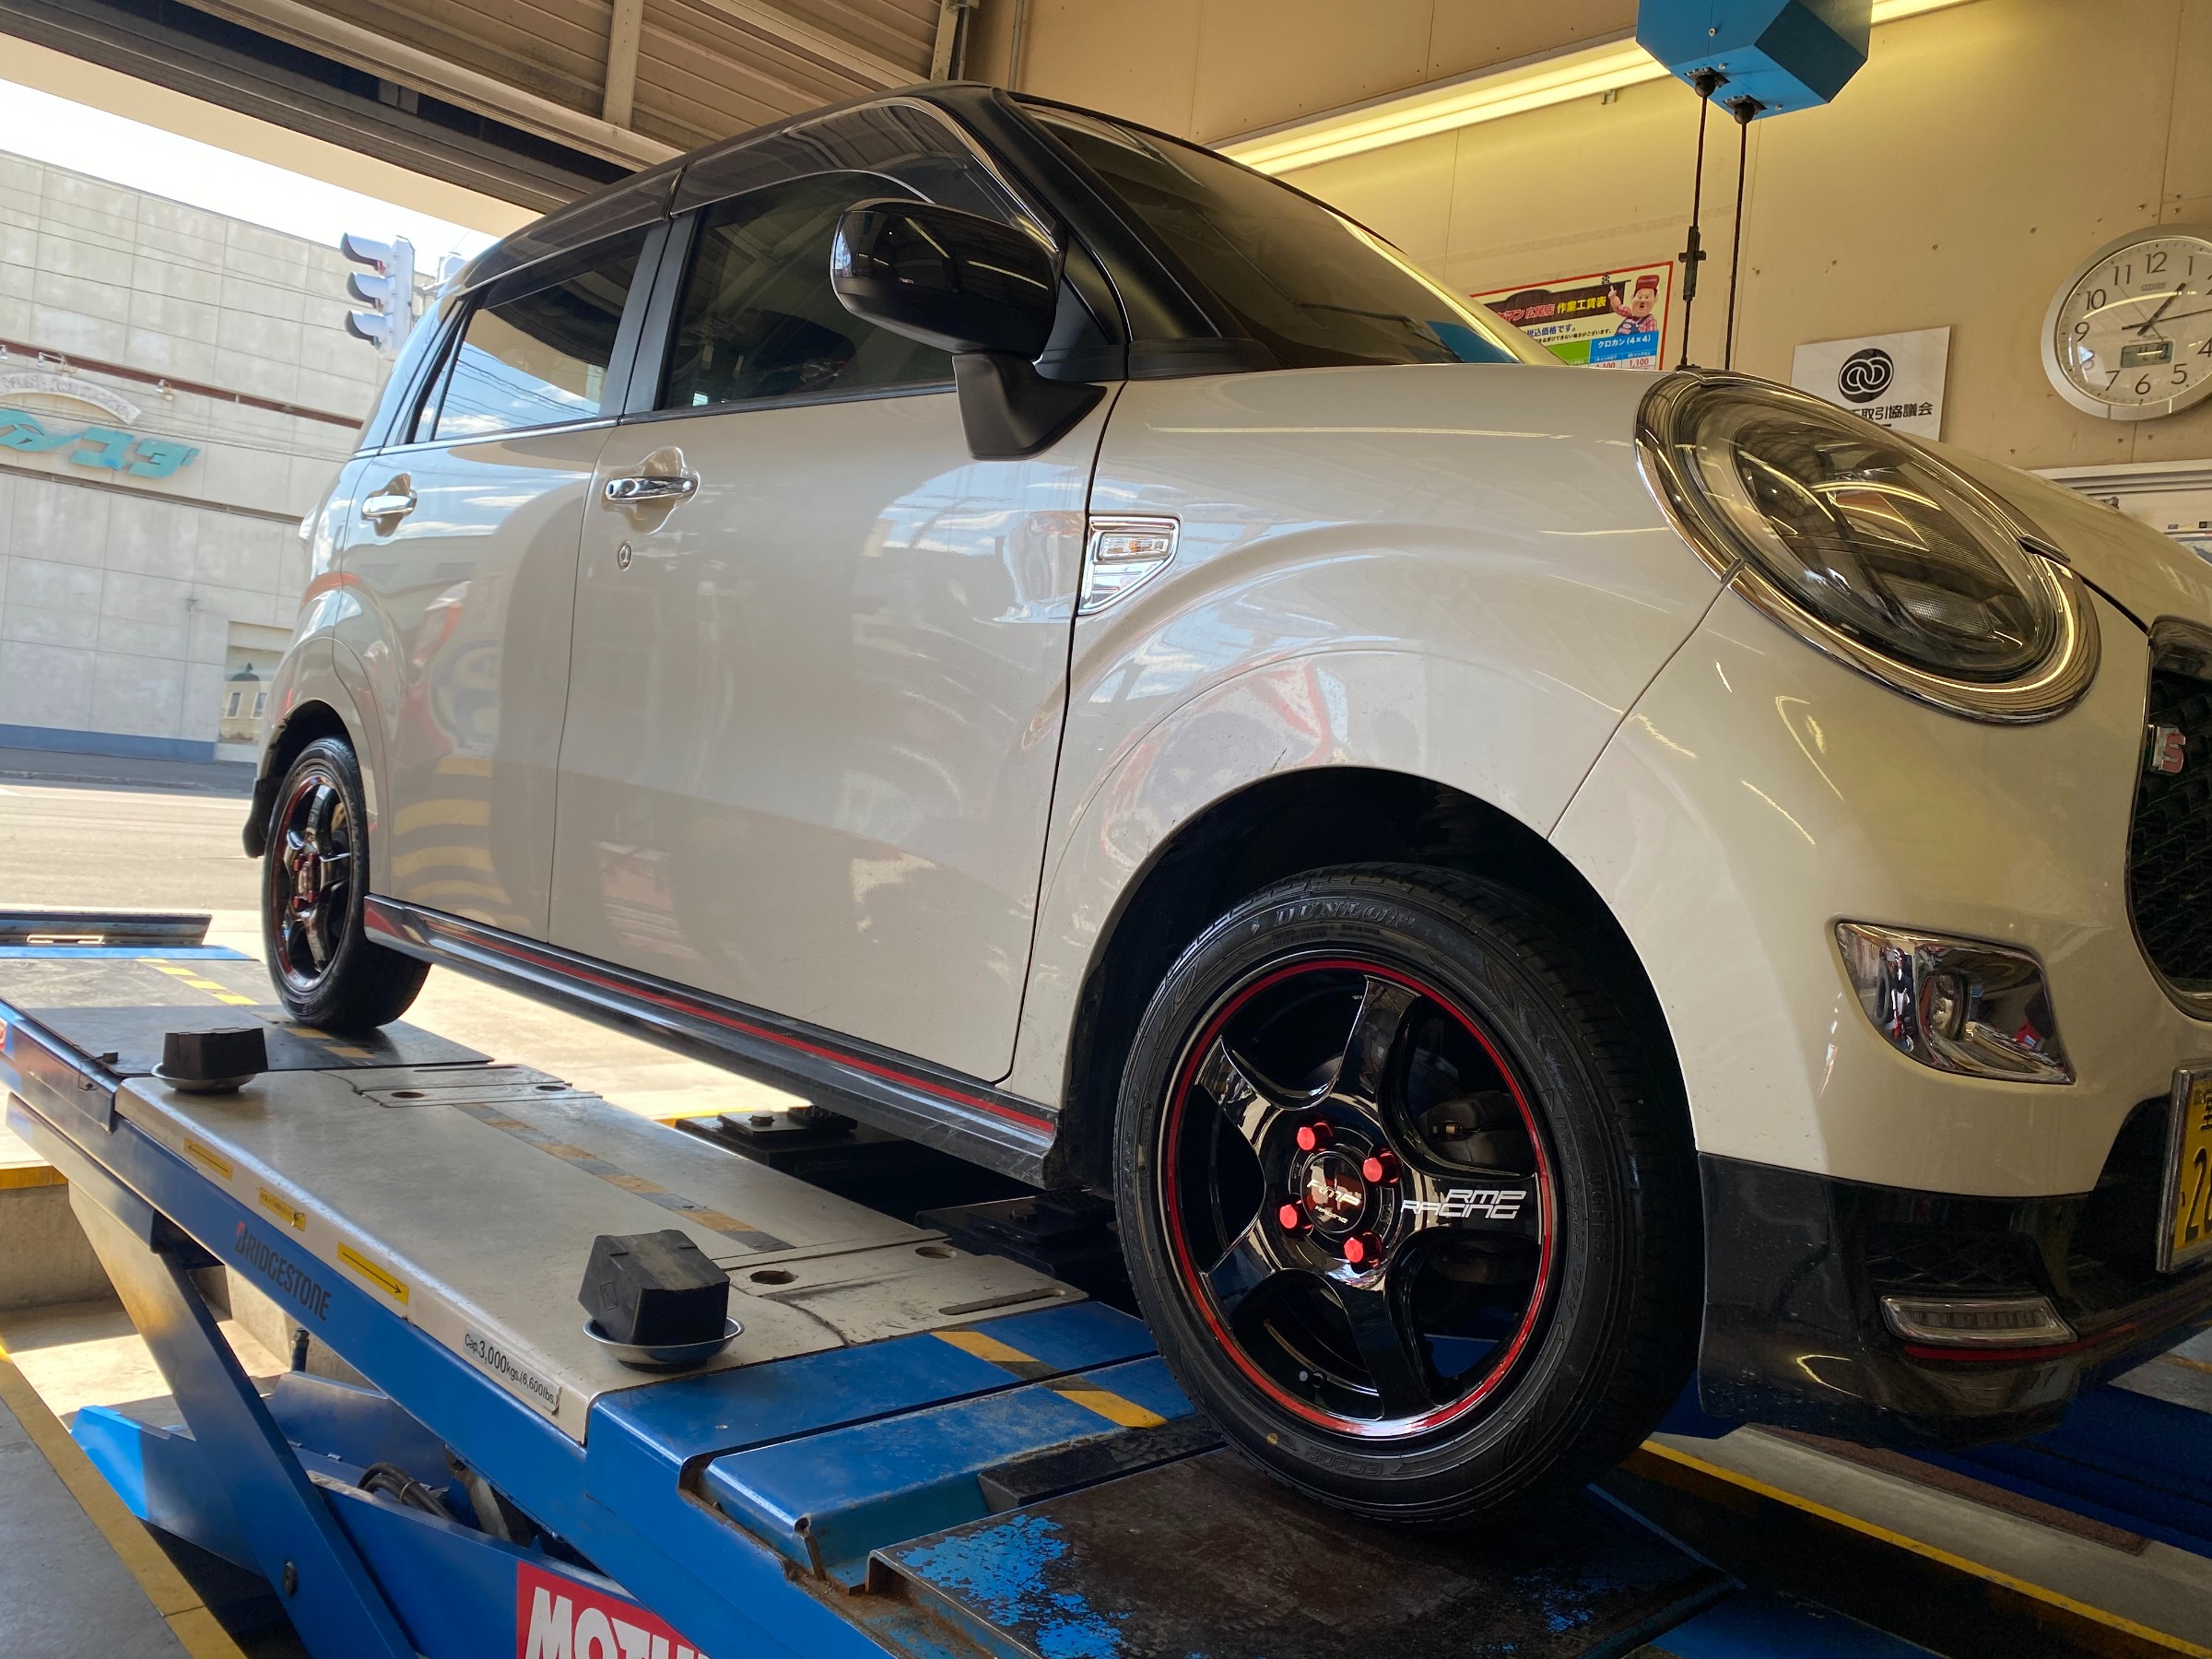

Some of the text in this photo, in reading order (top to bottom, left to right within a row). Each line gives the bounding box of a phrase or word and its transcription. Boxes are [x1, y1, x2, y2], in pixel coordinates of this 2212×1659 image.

[2146, 252, 2167, 274] 12
[2187, 255, 2194, 276] 1
[2114, 264, 2131, 286] 11
[2086, 288, 2106, 311] 10
[2075, 322, 2089, 342] 9
[2197, 337, 2212, 358] 4
[2105, 370, 2120, 391] 7
[2135, 373, 2151, 394] 6
[2171, 363, 2187, 384] 5
[1852, 402, 1934, 421] 取引協議会
[1274, 900, 1416, 928] DUNLOP
[1445, 1188, 1527, 1205] RMP
[2185, 1147, 2212, 1242] 2
[1401, 1199, 1521, 1219] RACING
[235, 1221, 332, 1322] BRIDGESTONE
